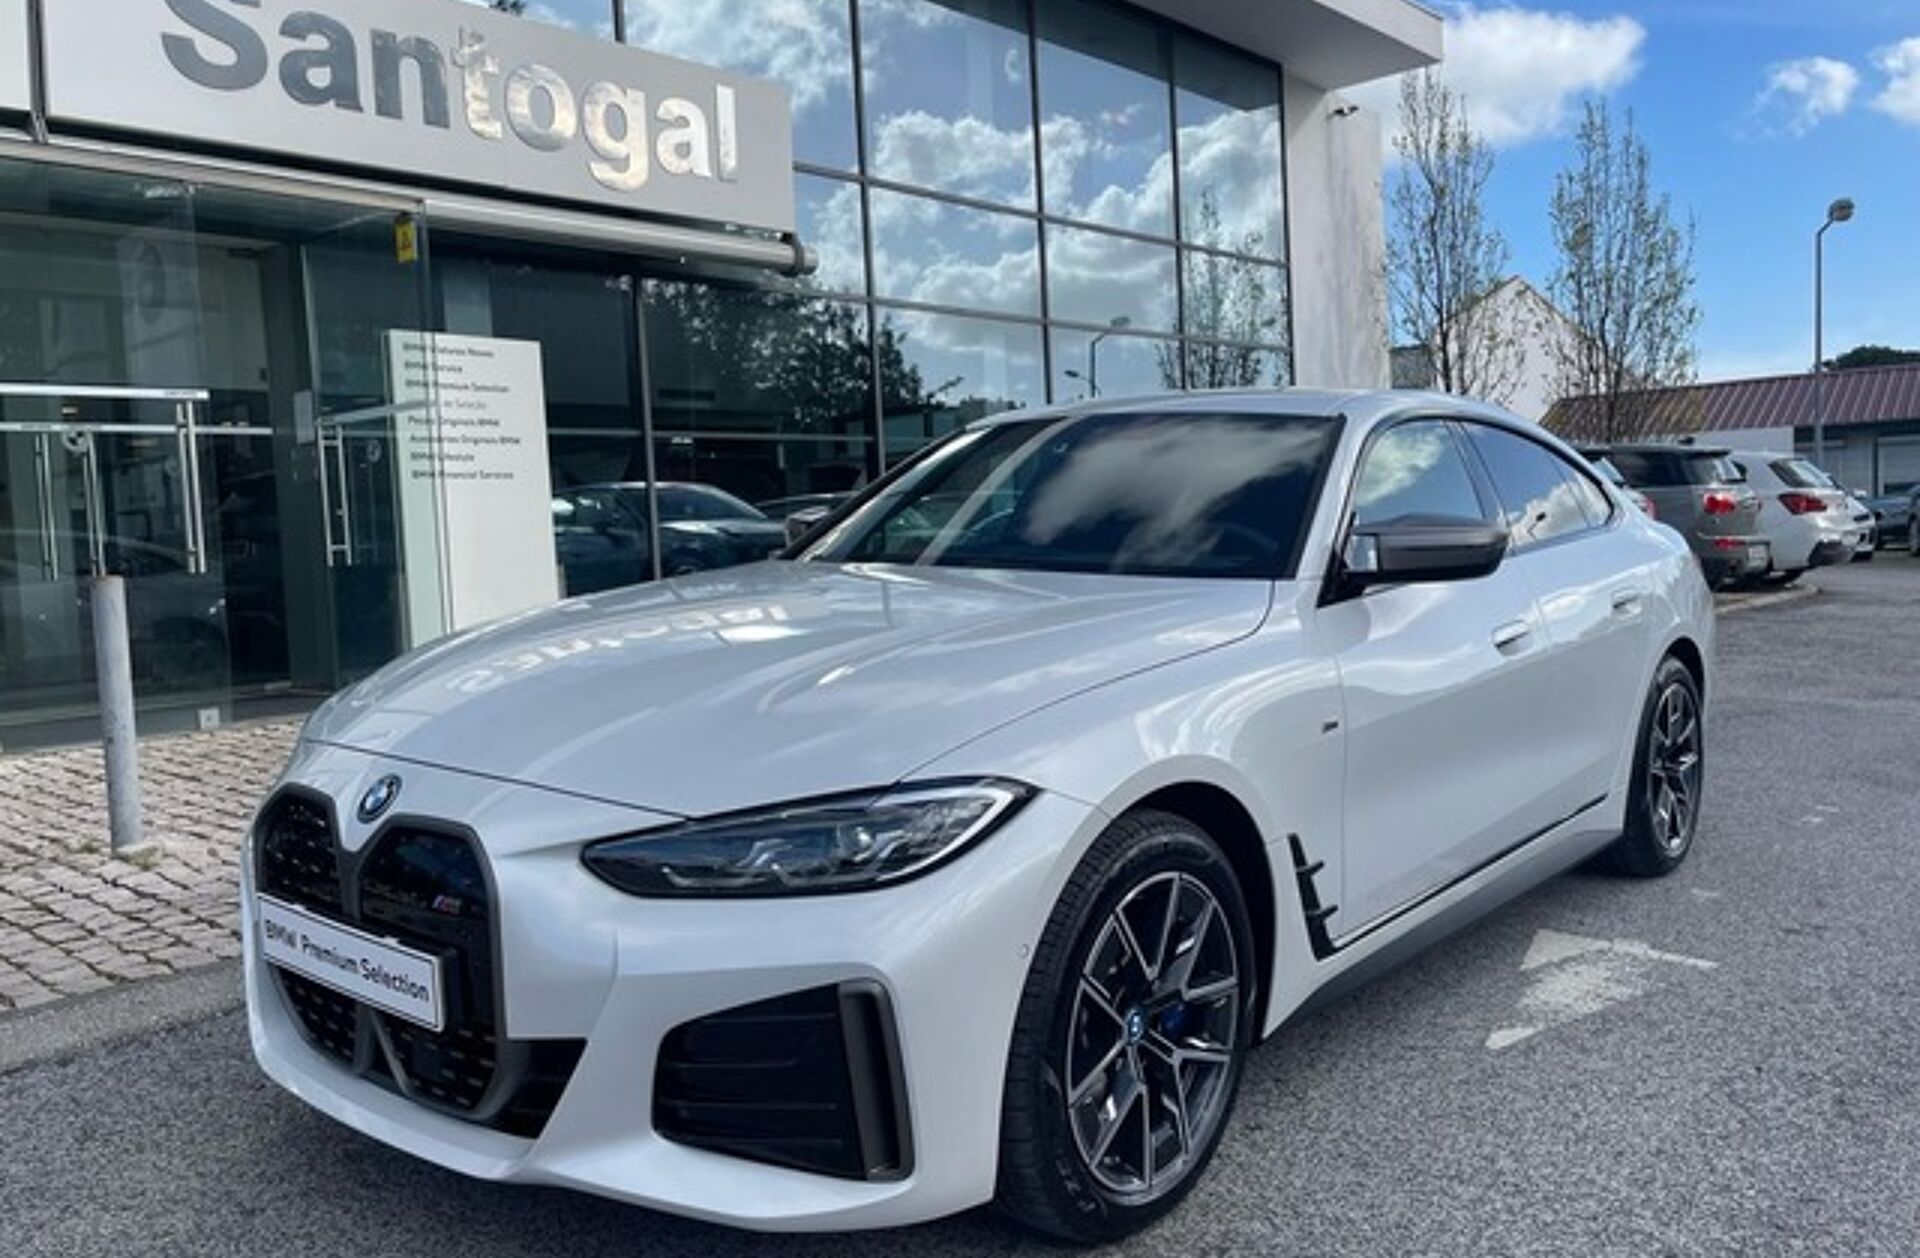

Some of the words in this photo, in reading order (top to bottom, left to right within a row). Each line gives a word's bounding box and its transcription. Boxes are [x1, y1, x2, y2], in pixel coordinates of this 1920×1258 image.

[160, 0, 738, 192] Santogal
[265, 918, 297, 949] BMW
[301, 933, 360, 974] Premium
[359, 957, 430, 1003] Selection
